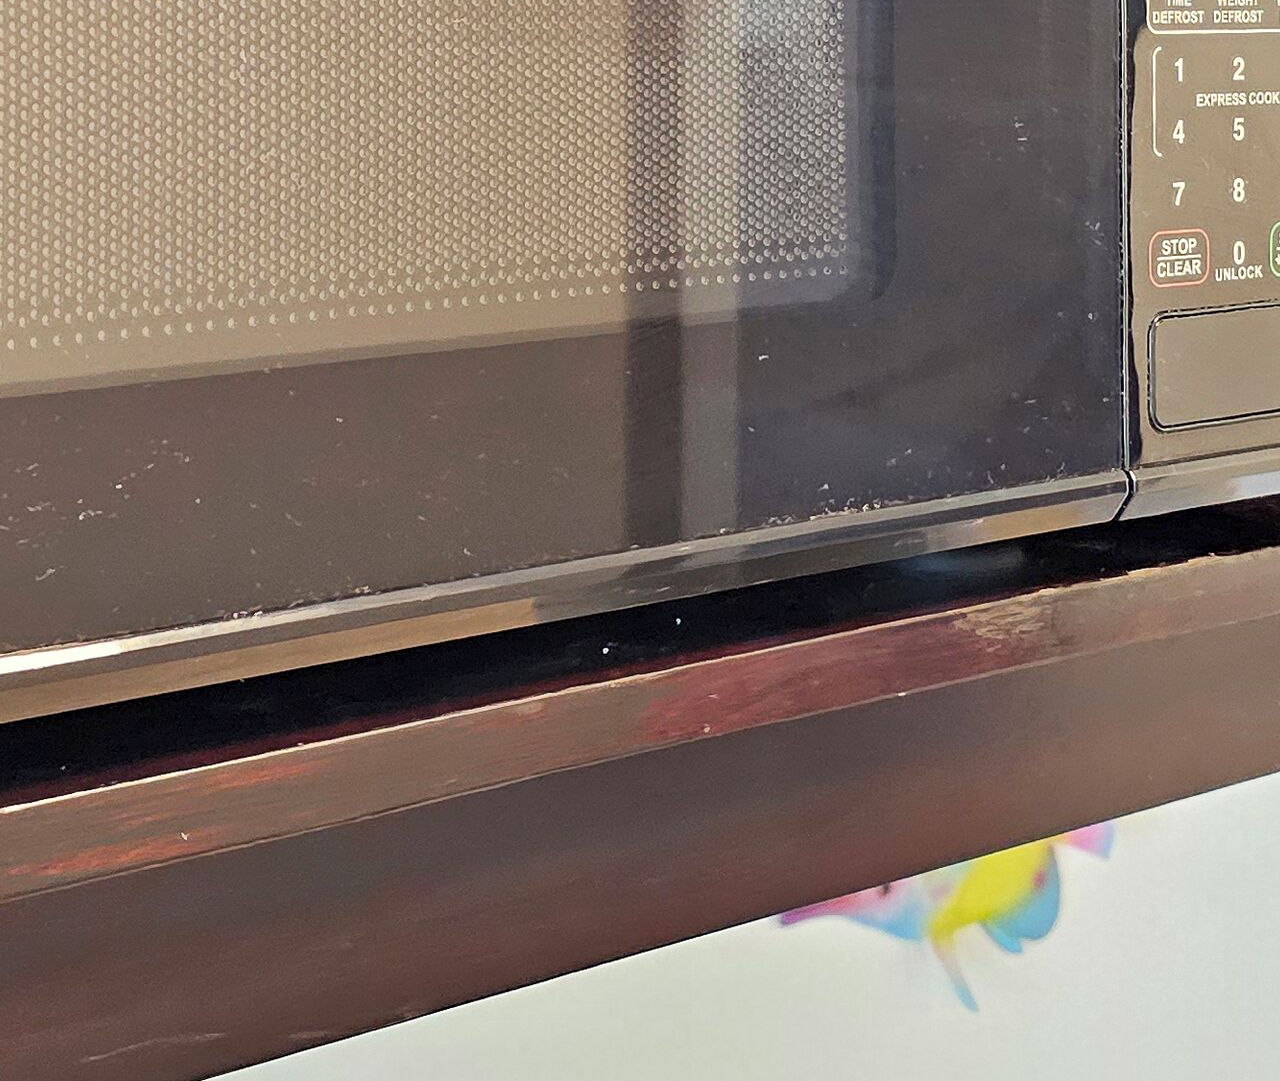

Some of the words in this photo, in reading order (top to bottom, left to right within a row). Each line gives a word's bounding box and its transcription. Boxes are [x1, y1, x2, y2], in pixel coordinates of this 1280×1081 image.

[1152, 11, 1205, 24] DEFROST
[1213, 10, 1263, 23] DEFROST
[1174, 58, 1184, 82] 1
[1232, 57, 1245, 81] 2
[1196, 93, 1247, 107] EXPRESS
[1249, 91, 1280, 105] COOK
[1172, 120, 1185, 144] 4
[1232, 117, 1245, 141] 5
[1172, 182, 1185, 206] 7
[1232, 178, 1245, 202] 8
[1162, 238, 1197, 255] STOP
[1233, 241, 1246, 265] 0
[1157, 260, 1201, 277] CLEAR
[1215, 265, 1263, 281] UNLOCK
